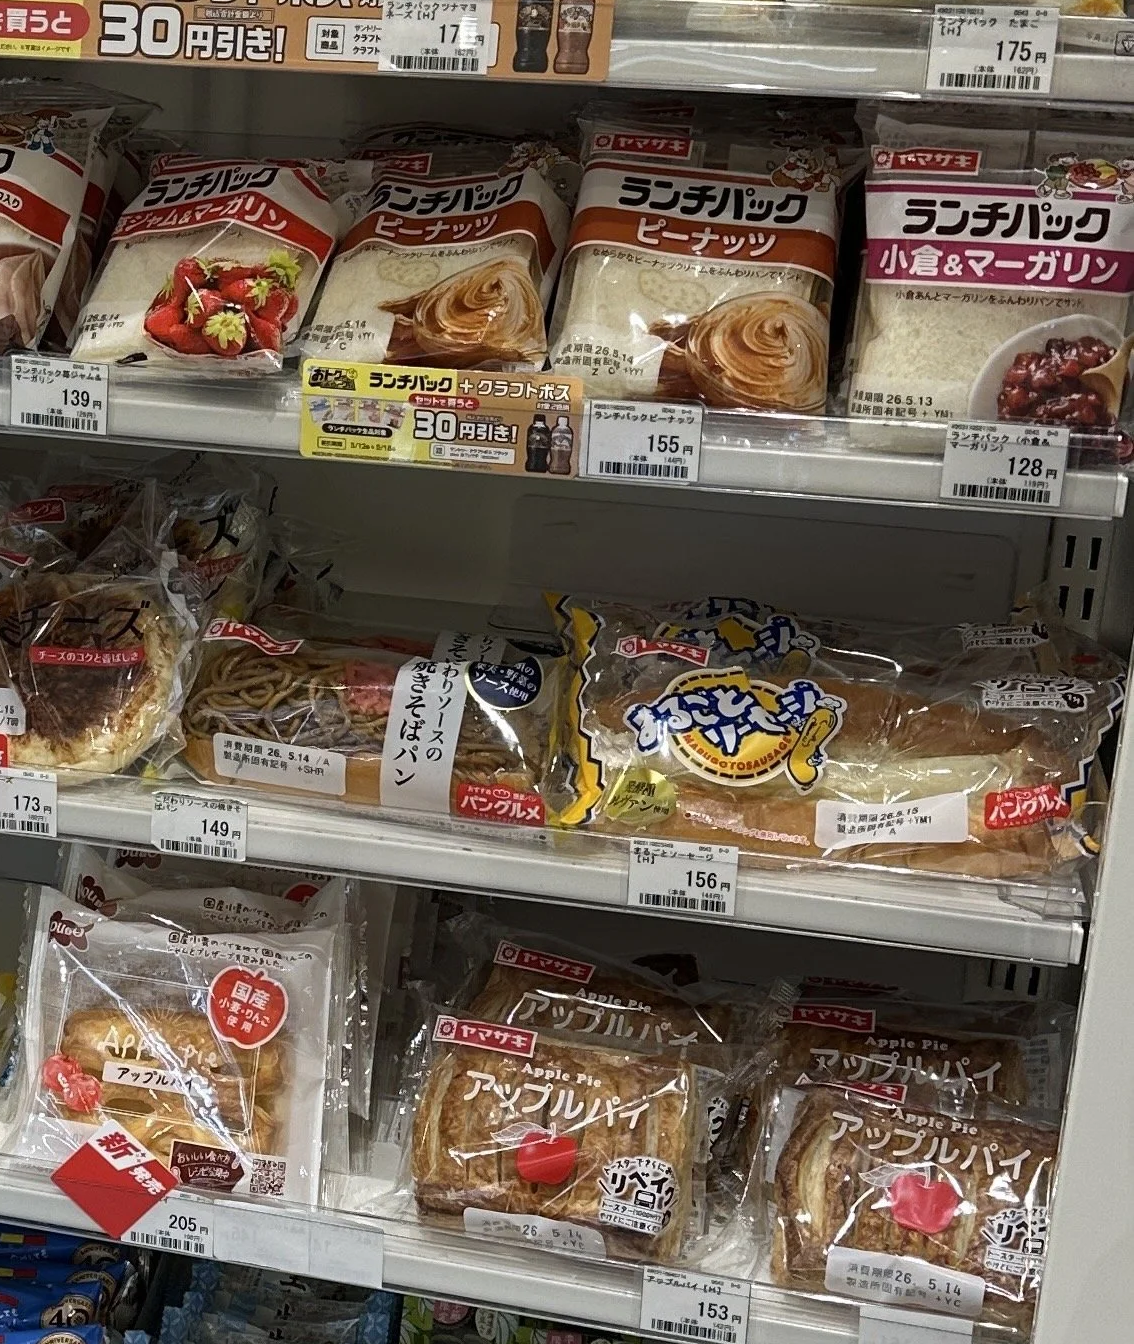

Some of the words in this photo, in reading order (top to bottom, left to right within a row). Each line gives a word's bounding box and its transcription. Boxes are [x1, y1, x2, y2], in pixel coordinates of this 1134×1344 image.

[101, 5, 285, 62] 30円引き!
[997, 41, 1046, 63] 175円
[614, 136, 685, 153] ヤマザキ
[145, 168, 278, 207] ランチパック
[375, 215, 499, 238] ピーナッツ
[903, 201, 1110, 241] ランチパック
[638, 218, 776, 254] ピーナッツ
[880, 245, 1118, 283] 小倉&マーガリン
[369, 374, 452, 392] ランチパック
[477, 381, 570, 401] クラフトボス
[414, 412, 517, 442] 30円引き!
[647, 435, 693, 454] 155円
[1008, 458, 1057, 478] 128円
[37, 648, 139, 662] チーズのコクと香ばしさ
[394, 660, 436, 786] 焼きそばパン
[224, 741, 263, 754] 消費期限
[682, 733, 794, 774] MARUGOTOSAUSAGE
[13, 796, 51, 815] 173円
[461, 796, 541, 820] パングルメ
[201, 820, 241, 840] 149円
[685, 870, 730, 891] 156円
[231, 984, 270, 1007] 国産
[219, 998, 270, 1027] 小麦・りんご
[226, 1015, 252, 1032] 使用
[461, 1022, 528, 1052] ヤマザキ
[522, 1061, 564, 1081] Apple
[574, 1075, 602, 1088] Pie
[465, 1071, 650, 1130] アップルパイ
[830, 1112, 1031, 1179] アップルパイ
[169, 1215, 209, 1235] 205円
[698, 1302, 742, 1324] 153円
